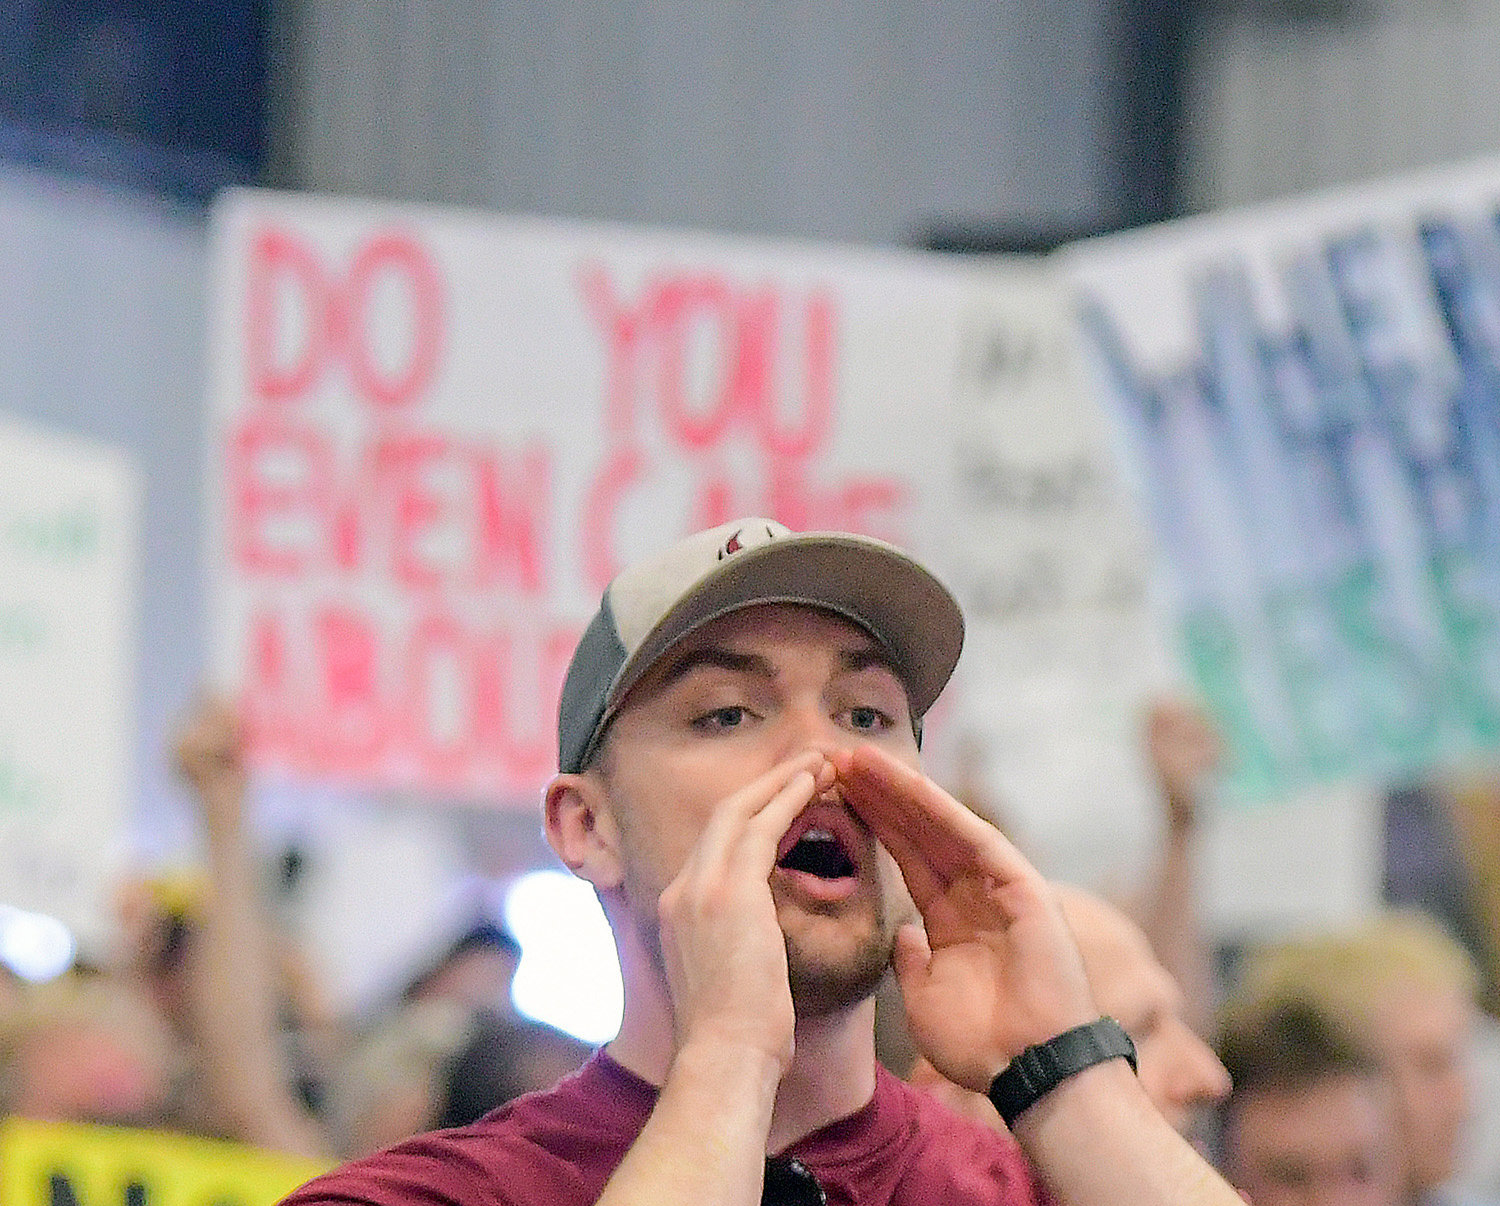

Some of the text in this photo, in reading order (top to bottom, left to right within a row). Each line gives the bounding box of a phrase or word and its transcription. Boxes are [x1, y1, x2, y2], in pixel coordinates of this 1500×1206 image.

[245, 222, 447, 408] DO
[572, 255, 838, 460] YOU
[230, 412, 552, 595] EVEN
